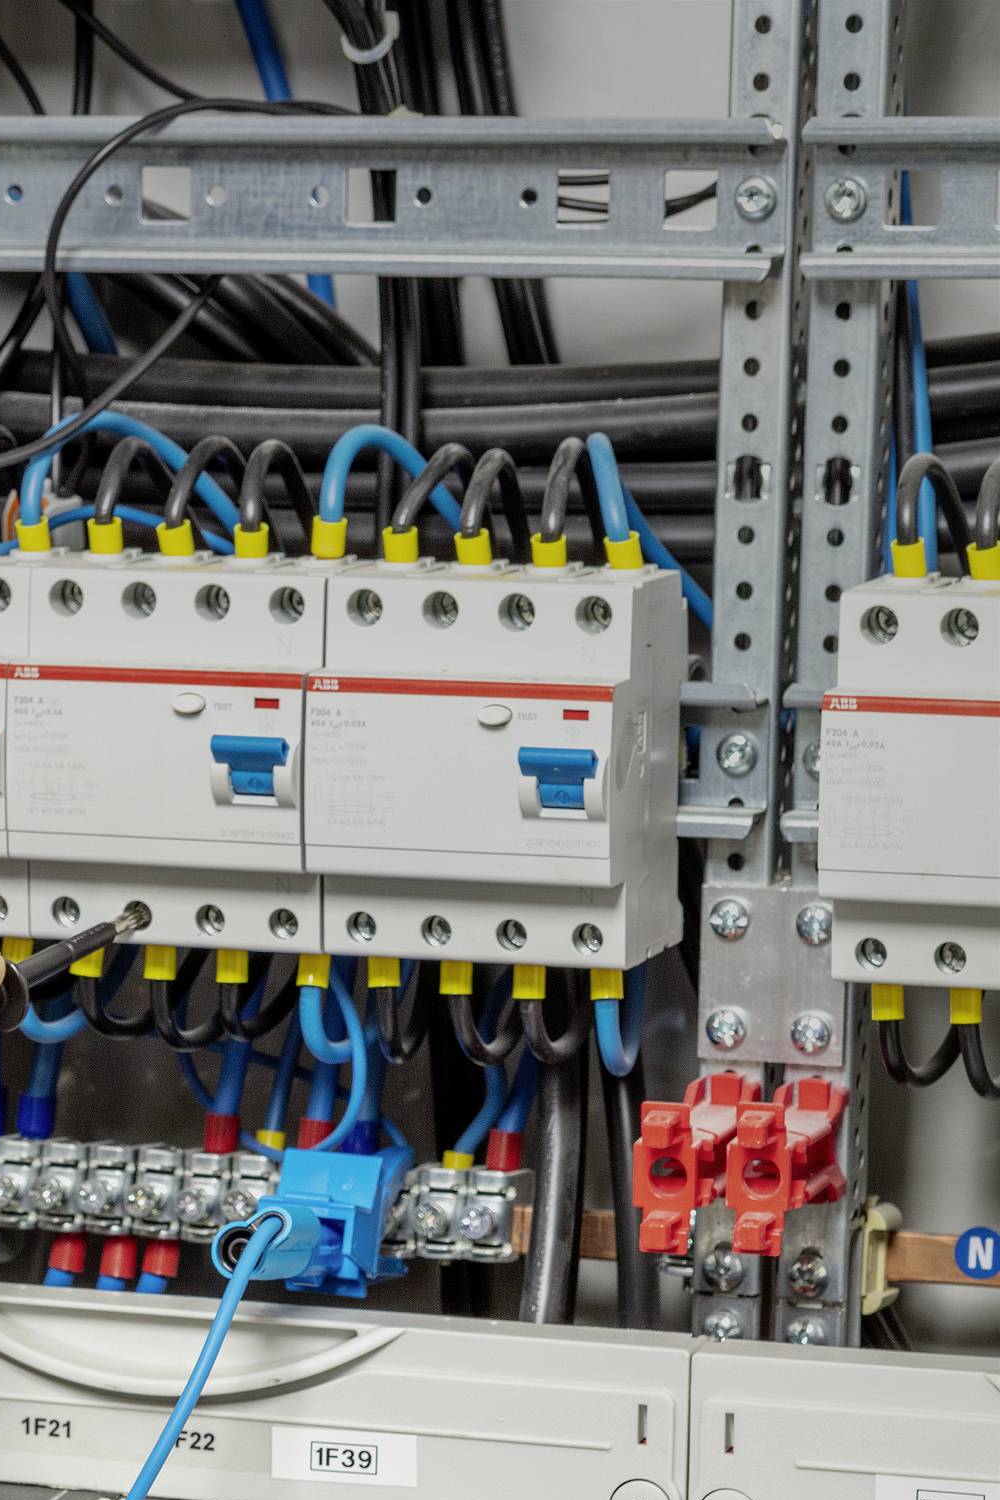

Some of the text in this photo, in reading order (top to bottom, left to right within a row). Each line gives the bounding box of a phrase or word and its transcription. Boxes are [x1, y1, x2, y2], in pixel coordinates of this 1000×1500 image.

[14, 666, 40, 679] ABB
[312, 679, 340, 691] ABB
[829, 697, 858, 710] ABB
[968, 1236, 994, 1270] N
[21, 1416, 72, 1439] 1F21
[316, 1447, 372, 1469] 1F39
